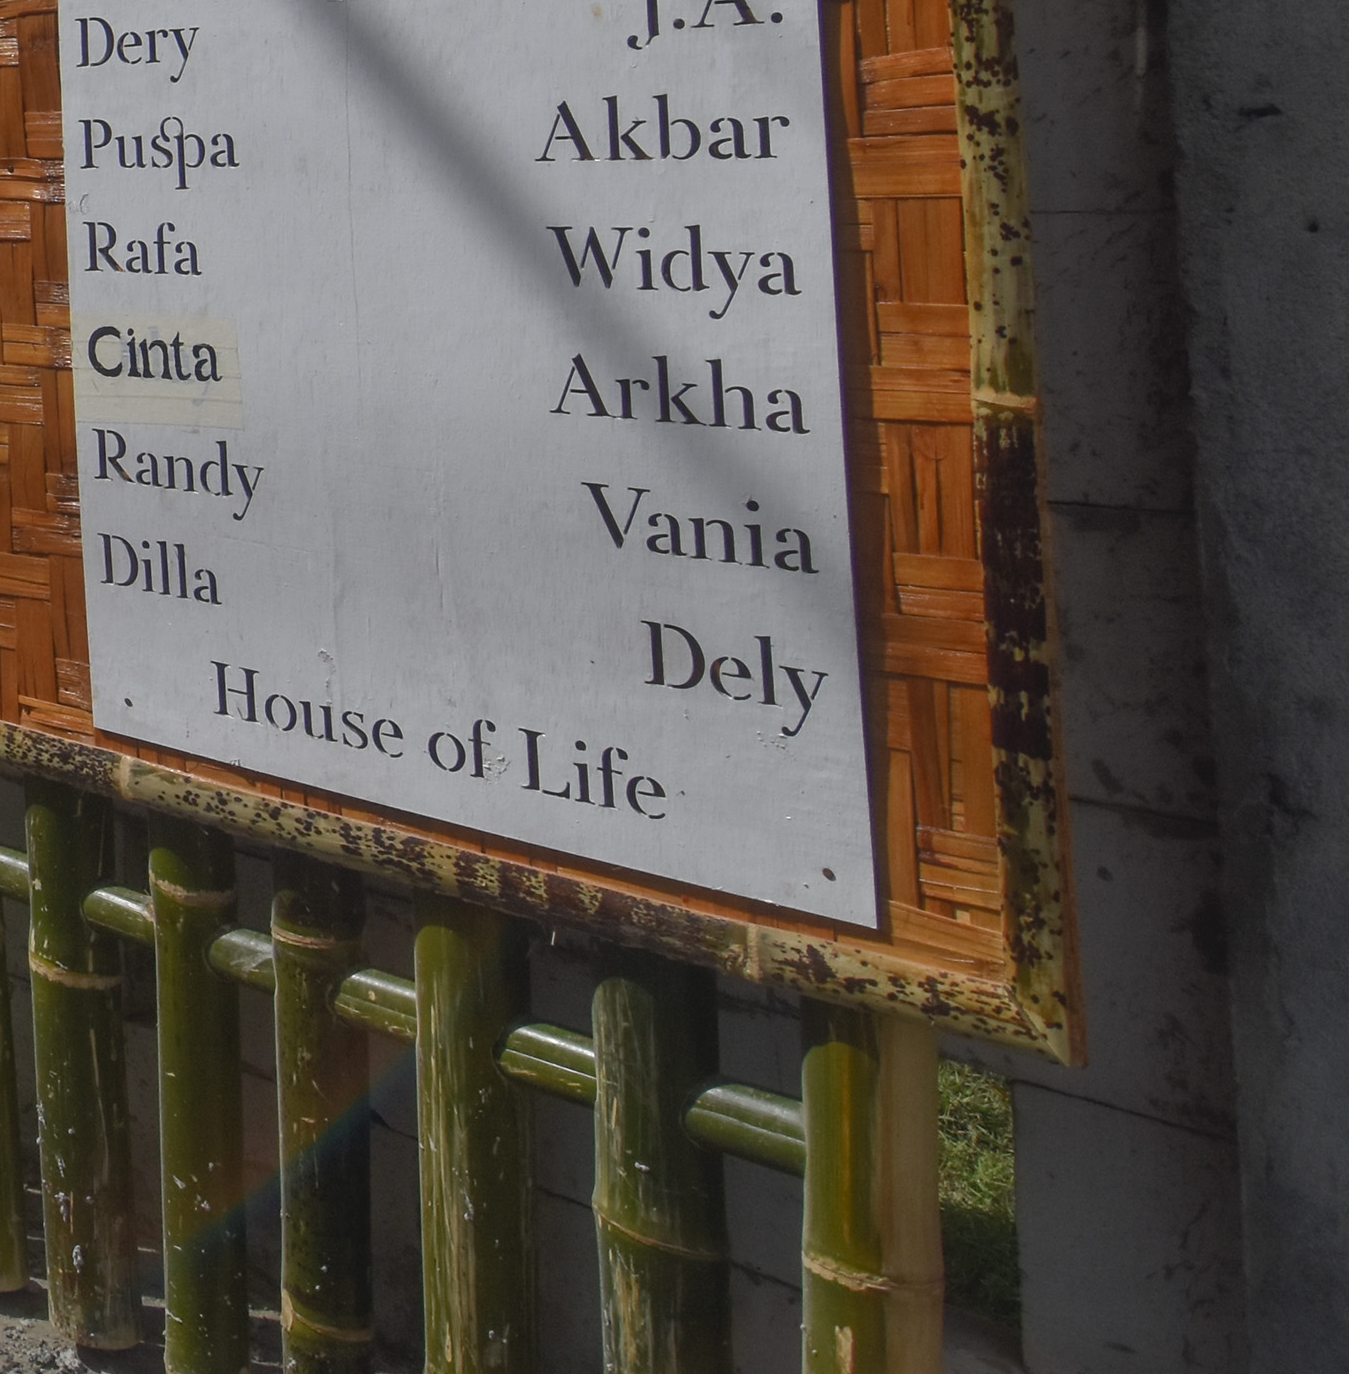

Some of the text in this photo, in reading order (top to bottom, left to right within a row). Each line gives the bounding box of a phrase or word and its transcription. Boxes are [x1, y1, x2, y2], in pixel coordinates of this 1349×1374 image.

[75, 17, 199, 83] Dery
[78, 116, 241, 190] Puspa
[534, 94, 789, 163] Akbar
[83, 221, 202, 276] Rafa
[547, 225, 802, 320] Widya
[87, 325, 223, 384] Cinta
[549, 353, 810, 436] Arkha
[93, 428, 265, 521] Randy
[581, 481, 820, 574] Vania
[97, 532, 223, 607] Dilla
[640, 619, 829, 738] Dely
[211, 660, 666, 820] House of Life
